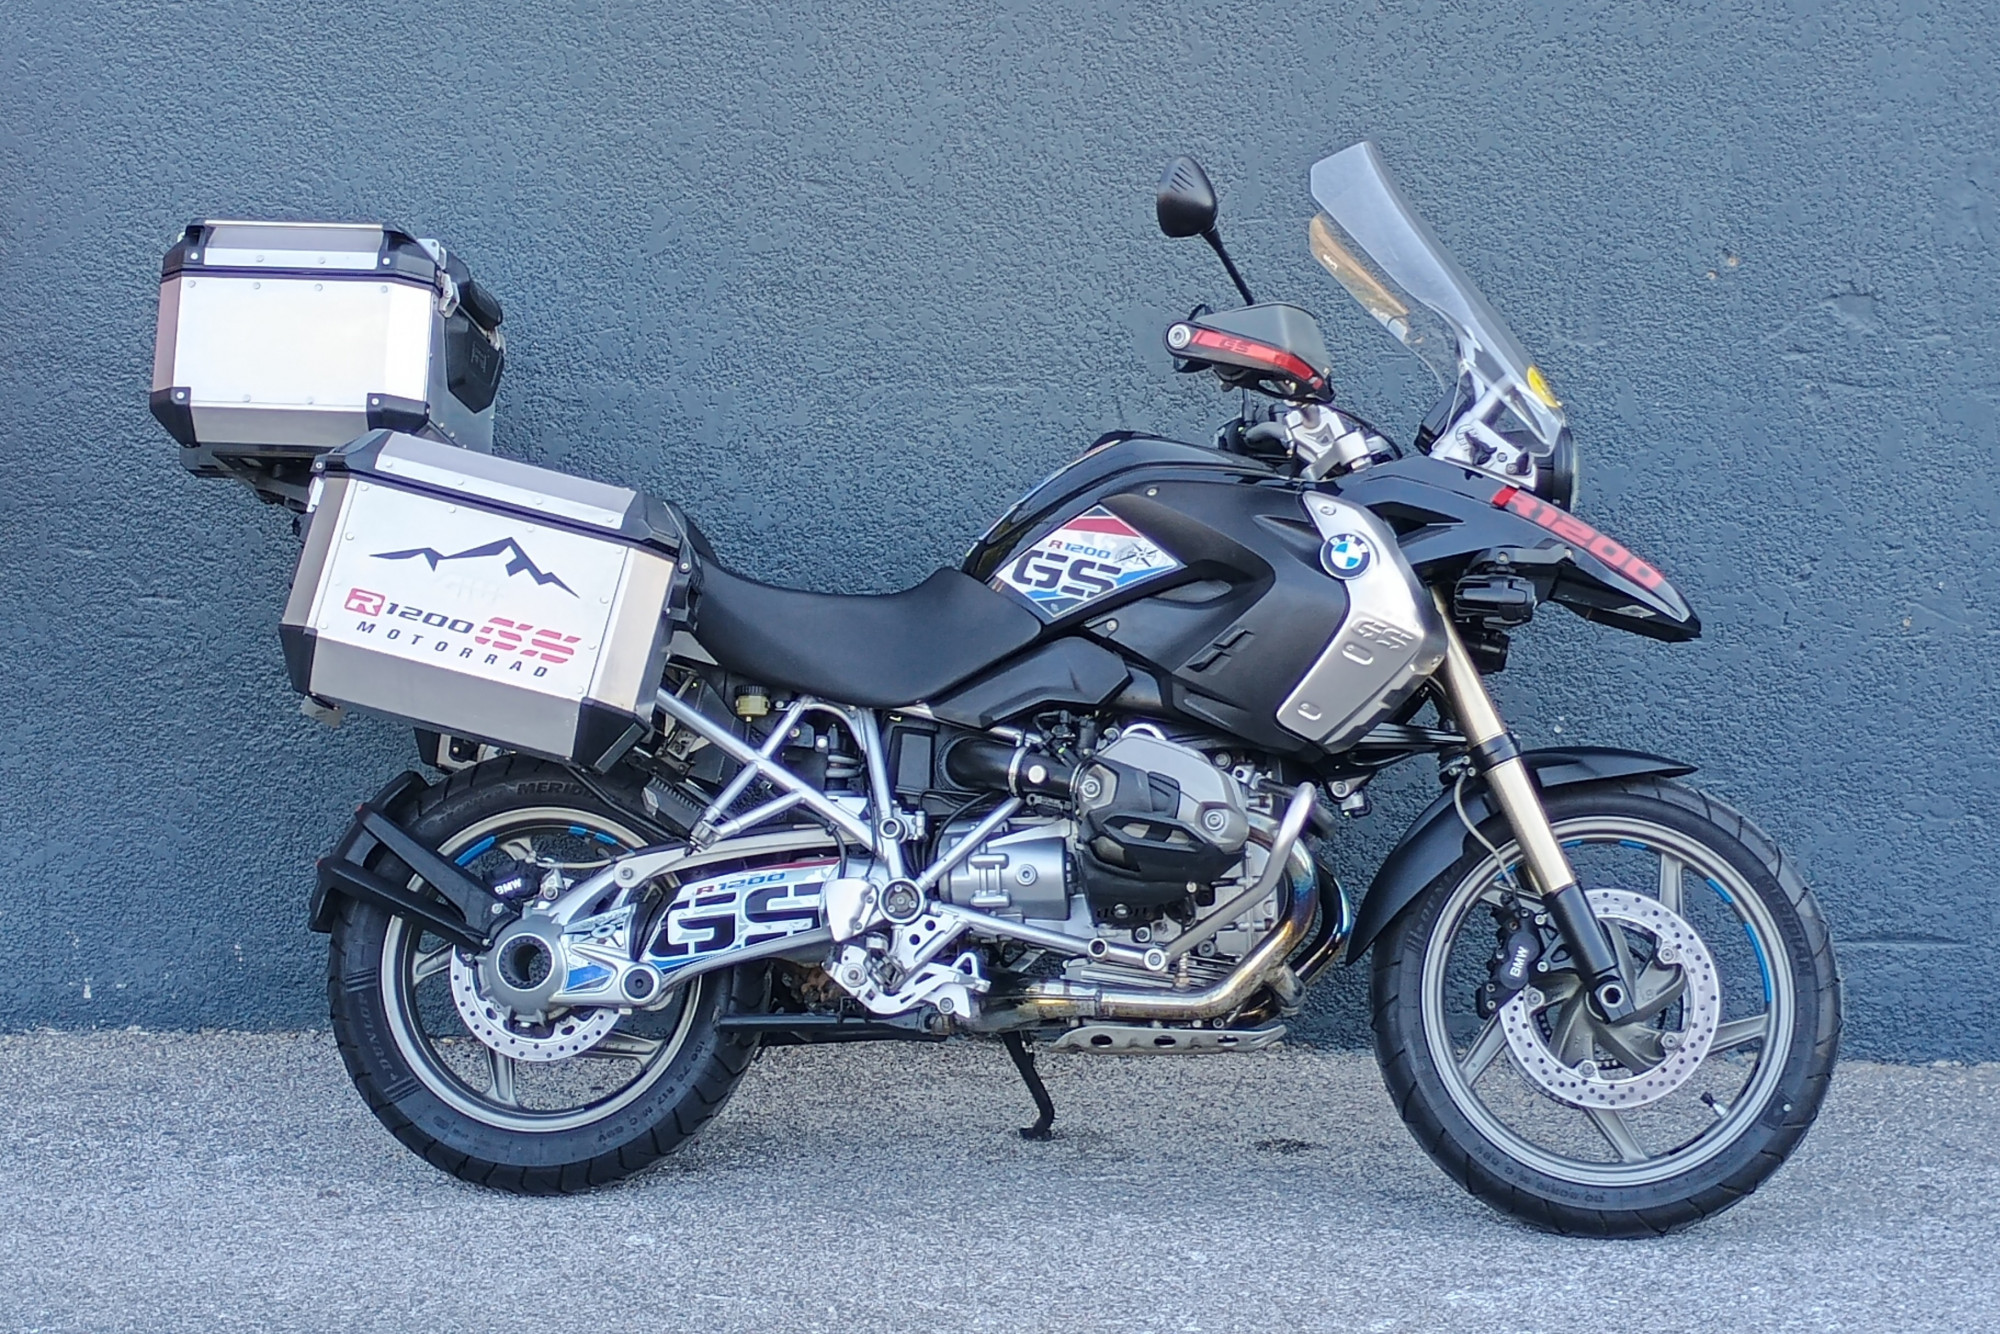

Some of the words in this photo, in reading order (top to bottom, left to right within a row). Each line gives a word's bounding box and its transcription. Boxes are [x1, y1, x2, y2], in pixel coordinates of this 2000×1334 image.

[1329, 535, 1369, 554] BMW
[1012, 549, 1122, 599] GS
[356, 621, 548, 678] MOTORRAD
[494, 877, 522, 895] BMW
[1510, 945, 1528, 977] BMW
